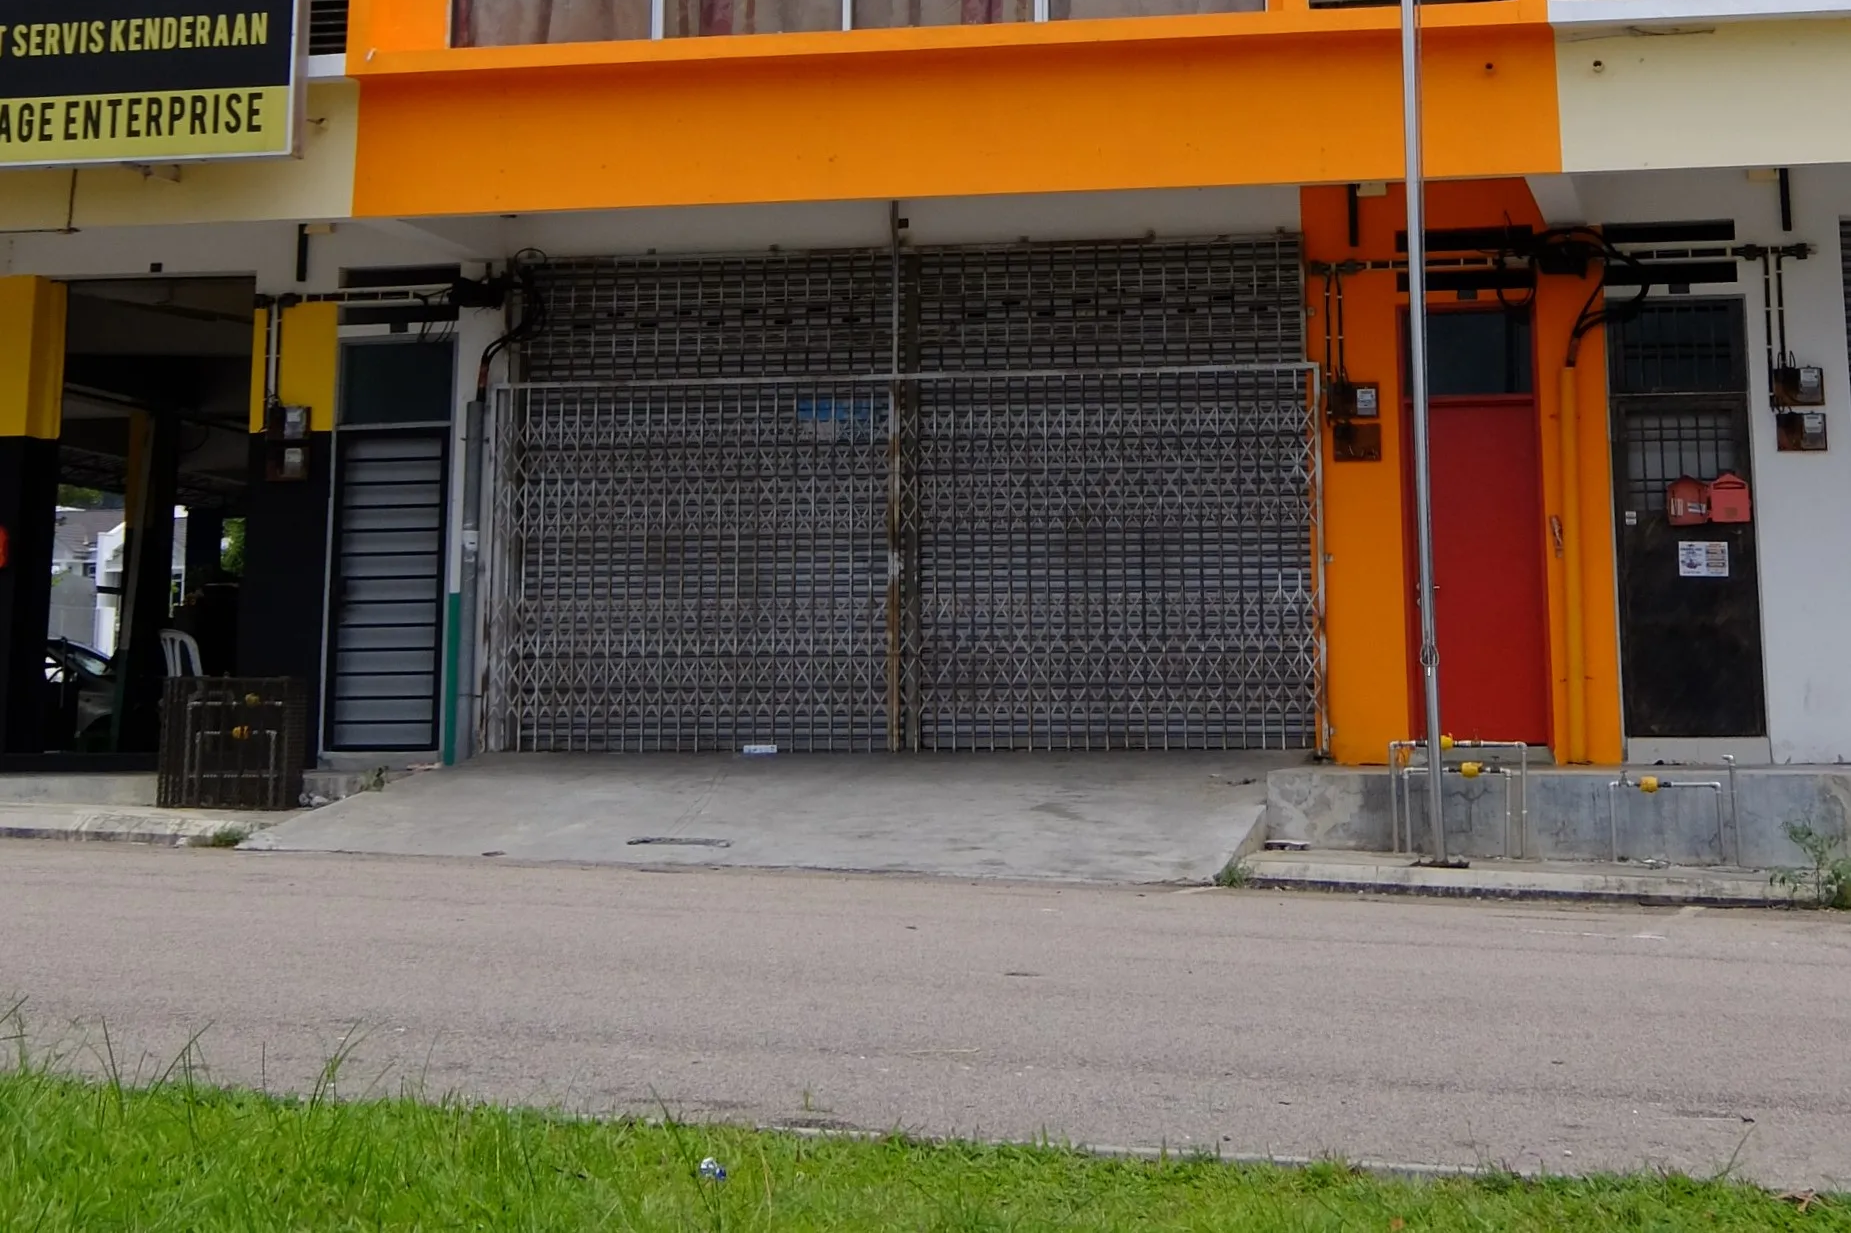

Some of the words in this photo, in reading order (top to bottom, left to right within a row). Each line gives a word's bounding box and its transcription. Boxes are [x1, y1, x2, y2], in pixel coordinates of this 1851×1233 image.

[11, 20, 106, 57] SERVIS
[110, 12, 268, 52] KENDERAAN
[0, 102, 55, 143] AGE
[63, 92, 264, 141] ENTERPRISE
